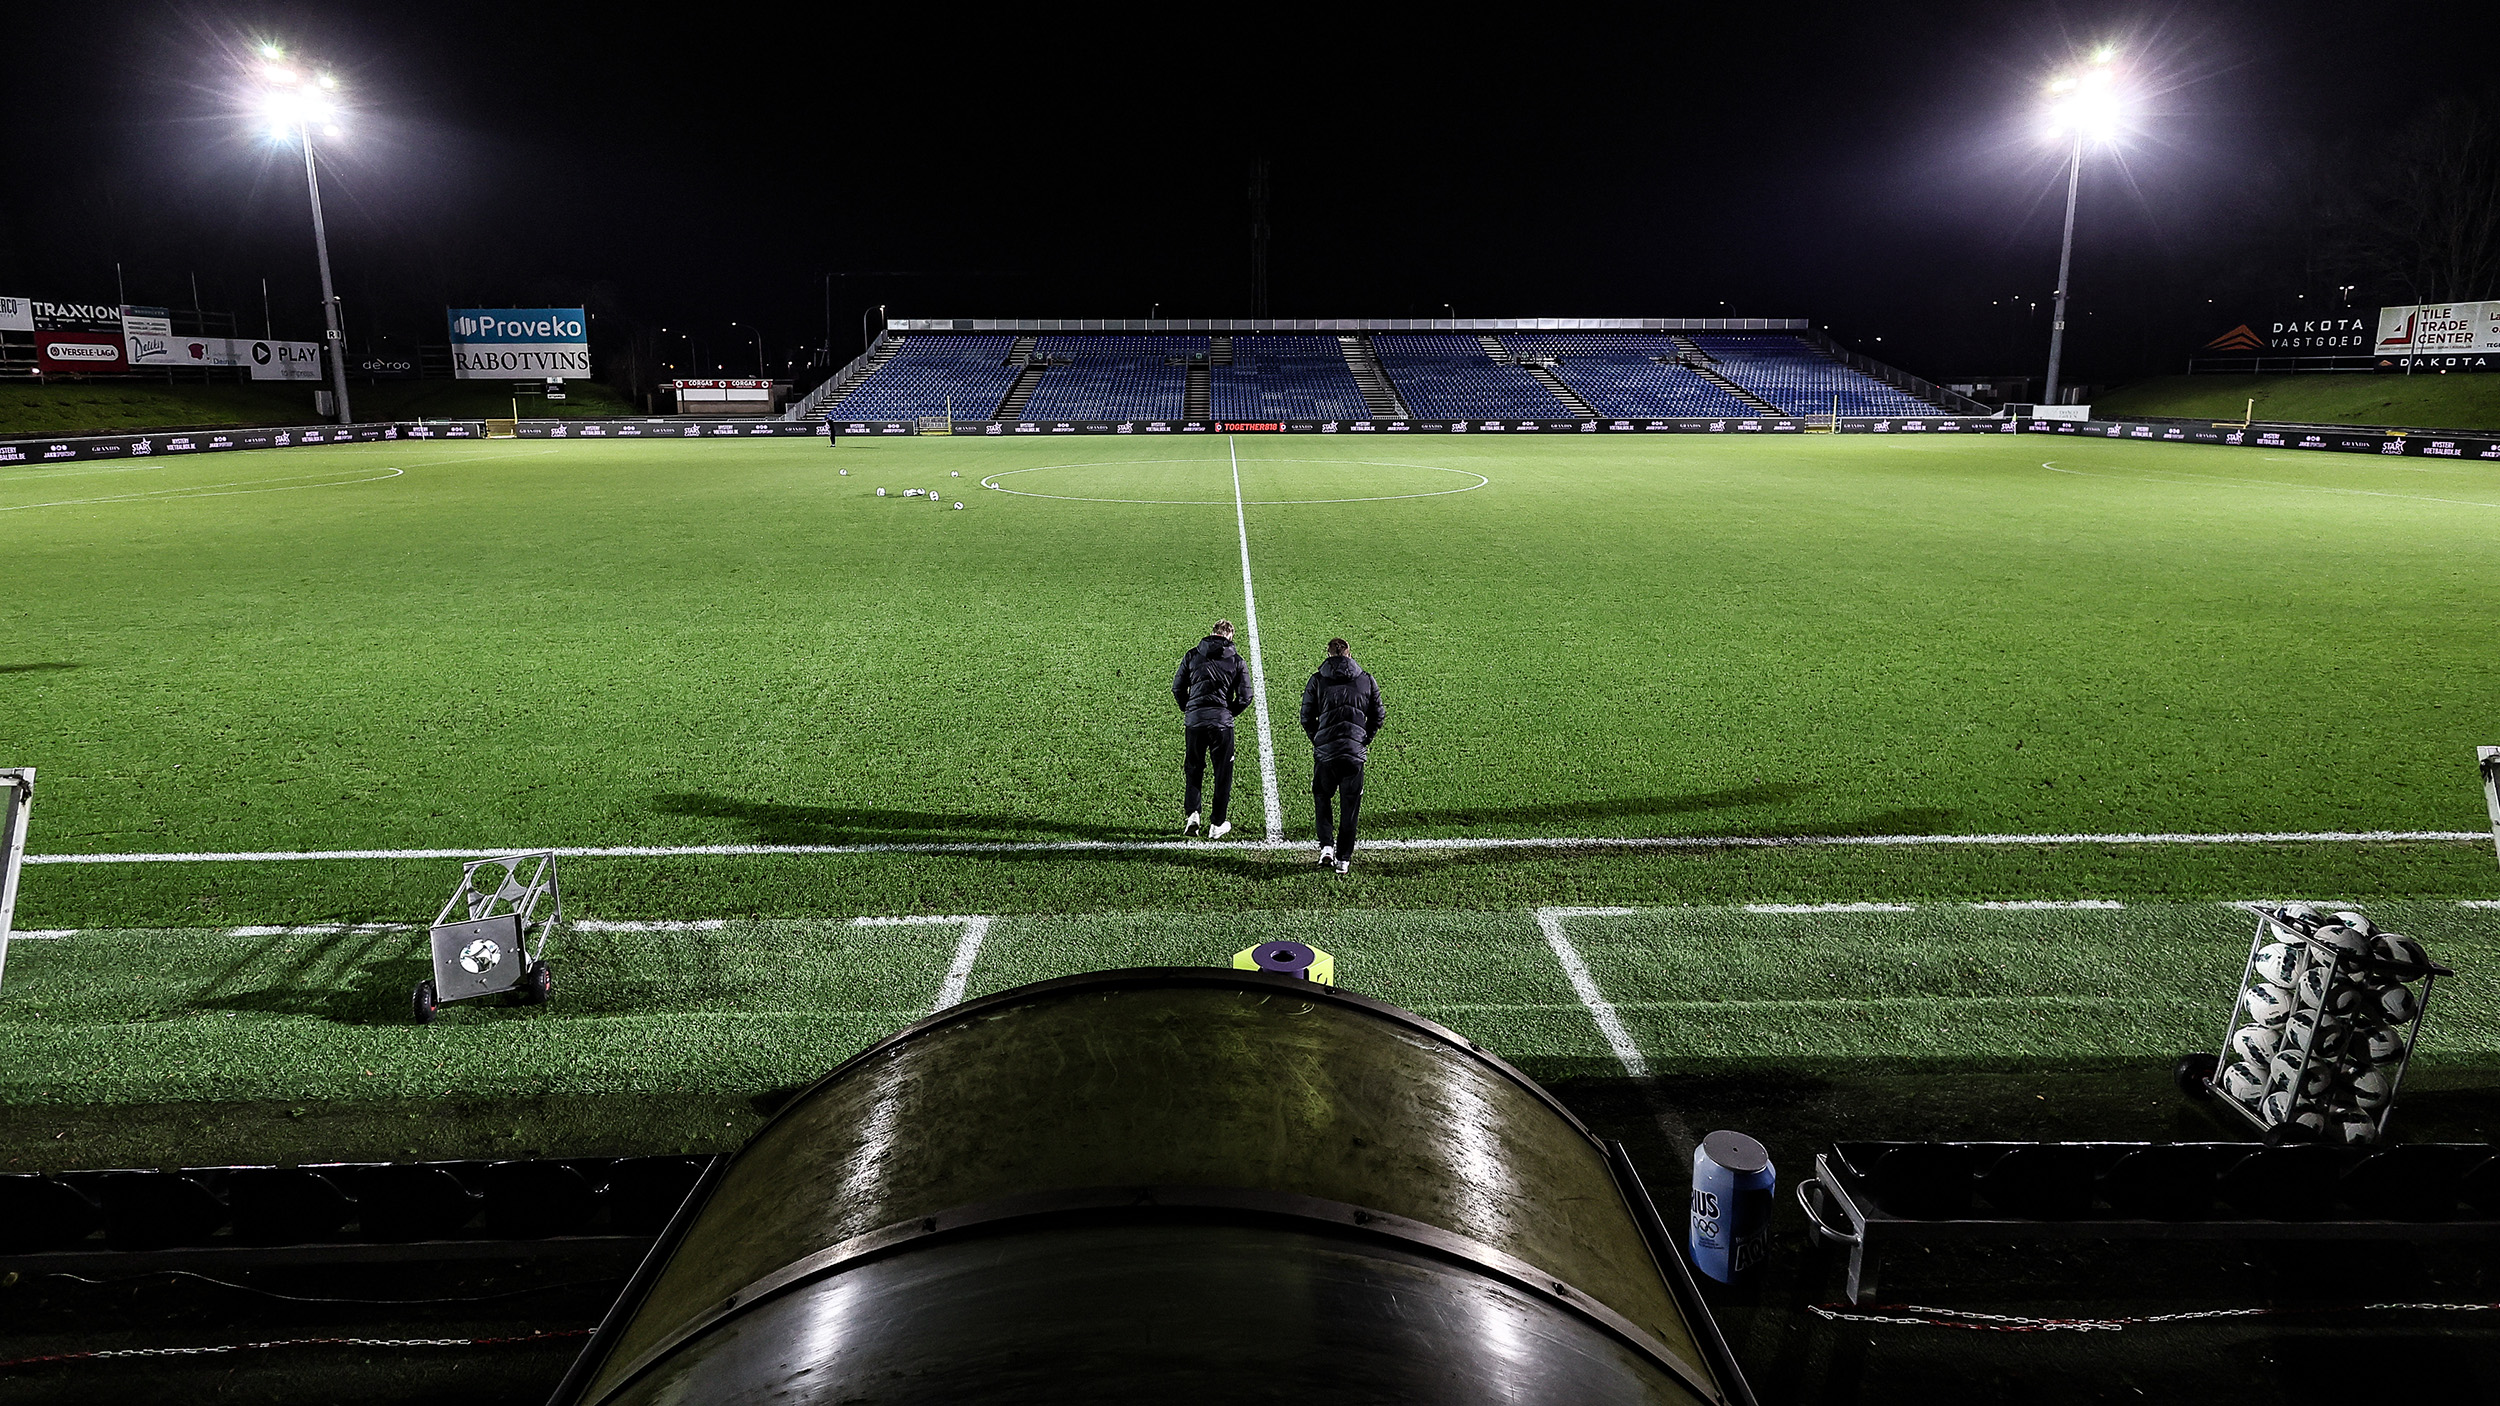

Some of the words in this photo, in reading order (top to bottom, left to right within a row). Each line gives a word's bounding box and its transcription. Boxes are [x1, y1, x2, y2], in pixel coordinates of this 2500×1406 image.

[32, 301, 120, 320] TRAXXION
[2422, 309, 2451, 319] TILE
[479, 315, 582, 337] Proveko
[2273, 319, 2363, 333] DAKOTA
[2421, 320, 2468, 331] TRADE
[2271, 336, 2362, 348] VASTGOED
[2418, 332, 2474, 344] CENTER
[61, 347, 115, 357] VERSELE-LAGA
[278, 347, 317, 362] PLAY
[454, 351, 589, 371] RABOTVINS
[2400, 357, 2486, 366] DAKOTA
[1225, 423, 1278, 431] TOGETHER818
[131, 440, 152, 451] STAR
[2382, 440, 2406, 451] STAR
[1691, 1189, 1720, 1219] IUS
